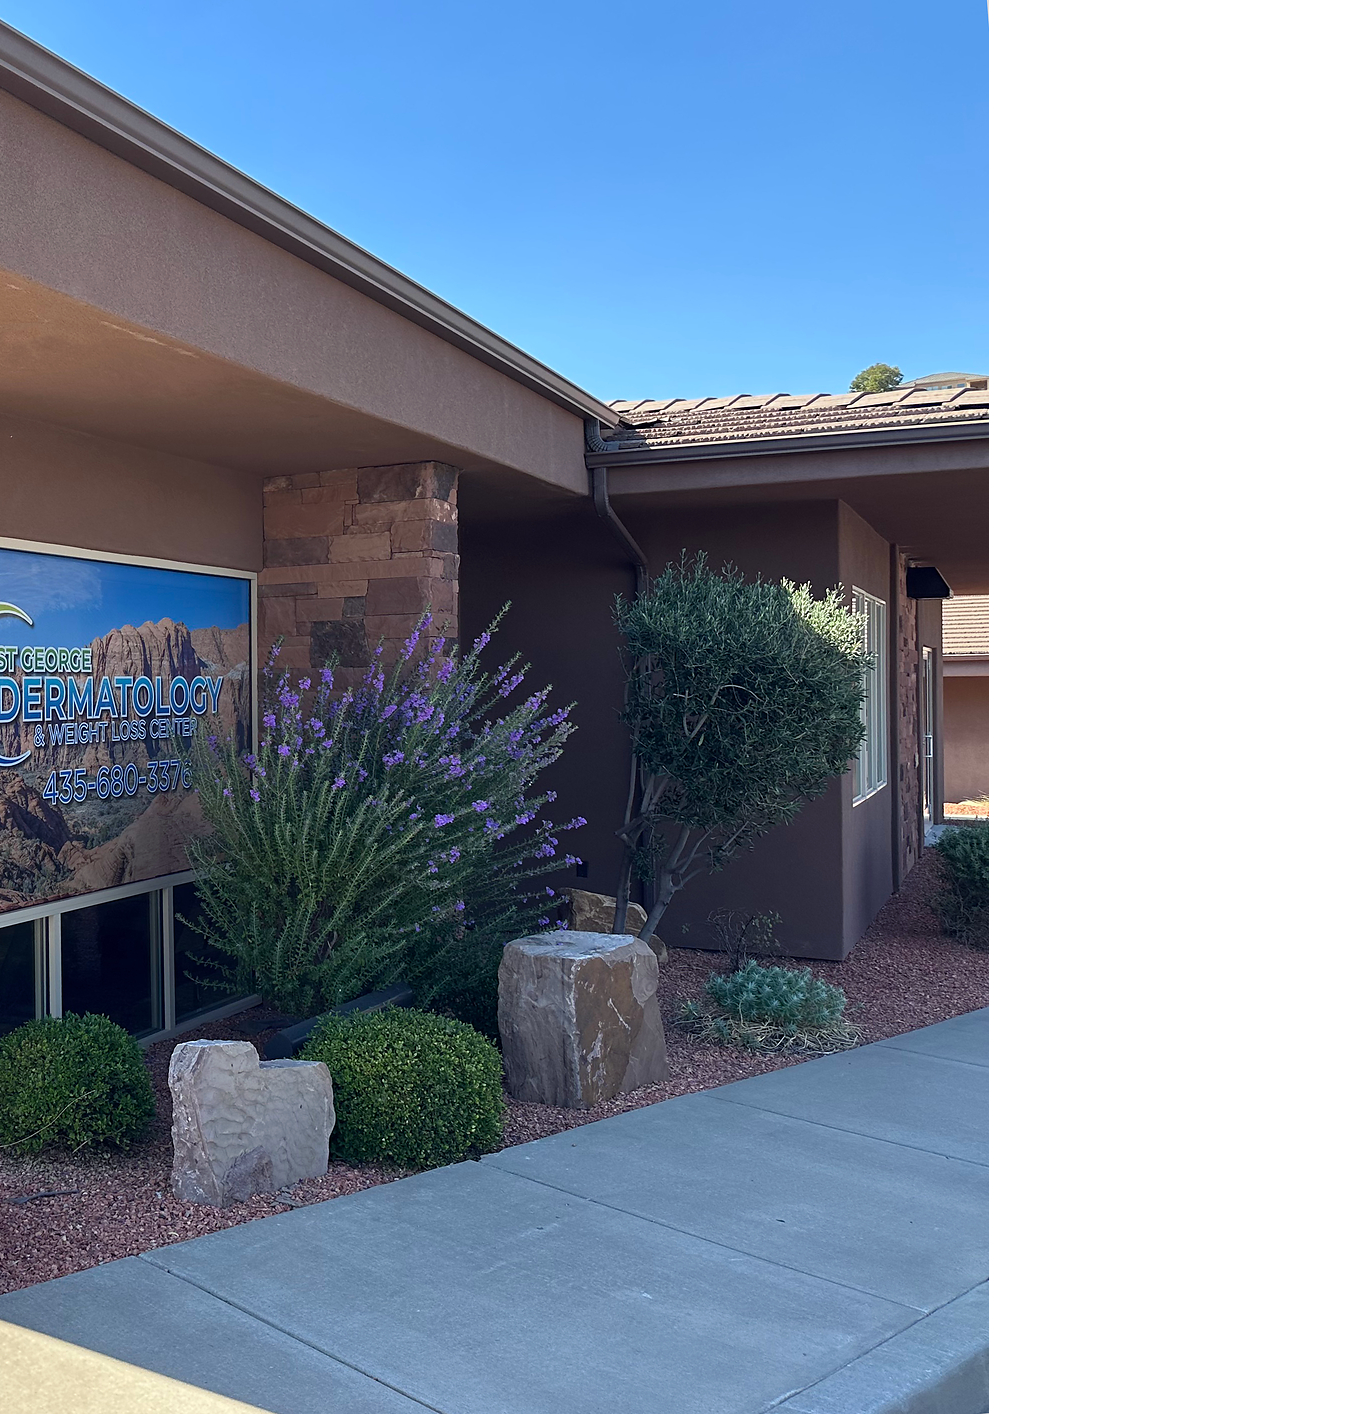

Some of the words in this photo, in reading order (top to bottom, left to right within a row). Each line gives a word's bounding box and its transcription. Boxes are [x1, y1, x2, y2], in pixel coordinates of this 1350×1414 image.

[20, 646, 92, 673] GEORGE
[33, 725, 46, 747] &
[48, 721, 108, 745] WEIGHT
[111, 719, 147, 742] LOSS
